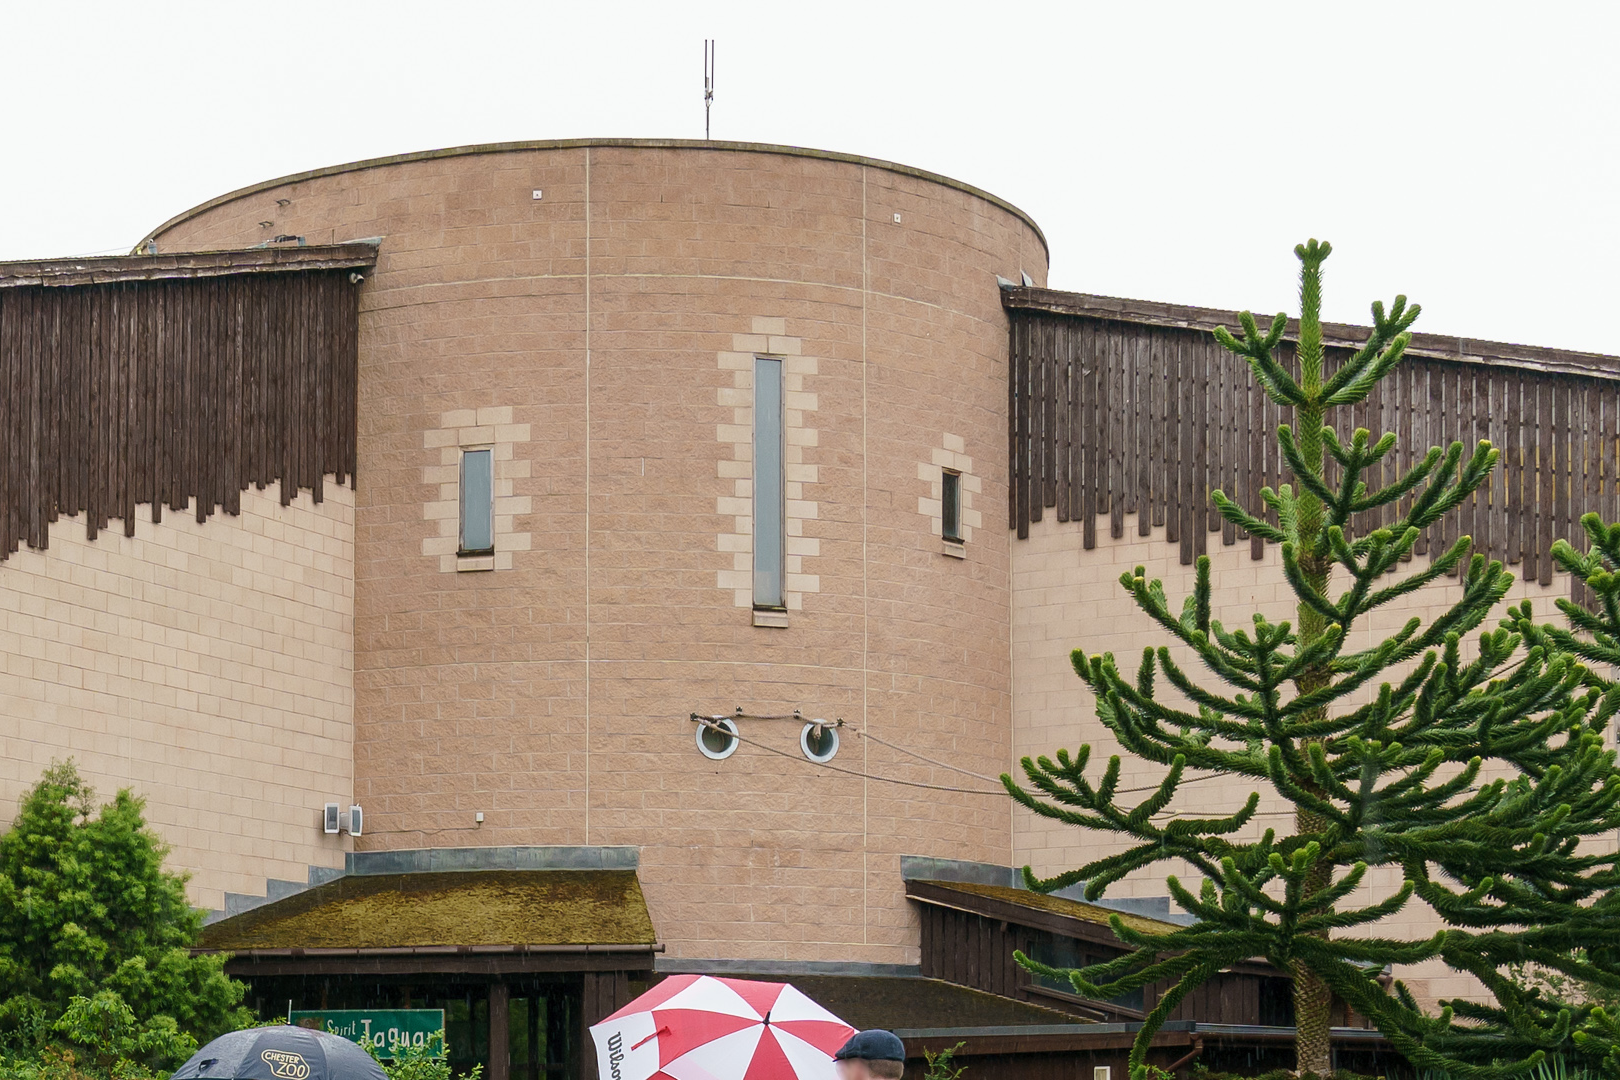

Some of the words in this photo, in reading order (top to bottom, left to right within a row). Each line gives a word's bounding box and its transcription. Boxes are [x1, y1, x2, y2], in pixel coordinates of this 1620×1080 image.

[327, 1019, 356, 1036] Spirit
[264, 1052, 300, 1064] CHESTER
[276, 1061, 306, 1077] ZOO
